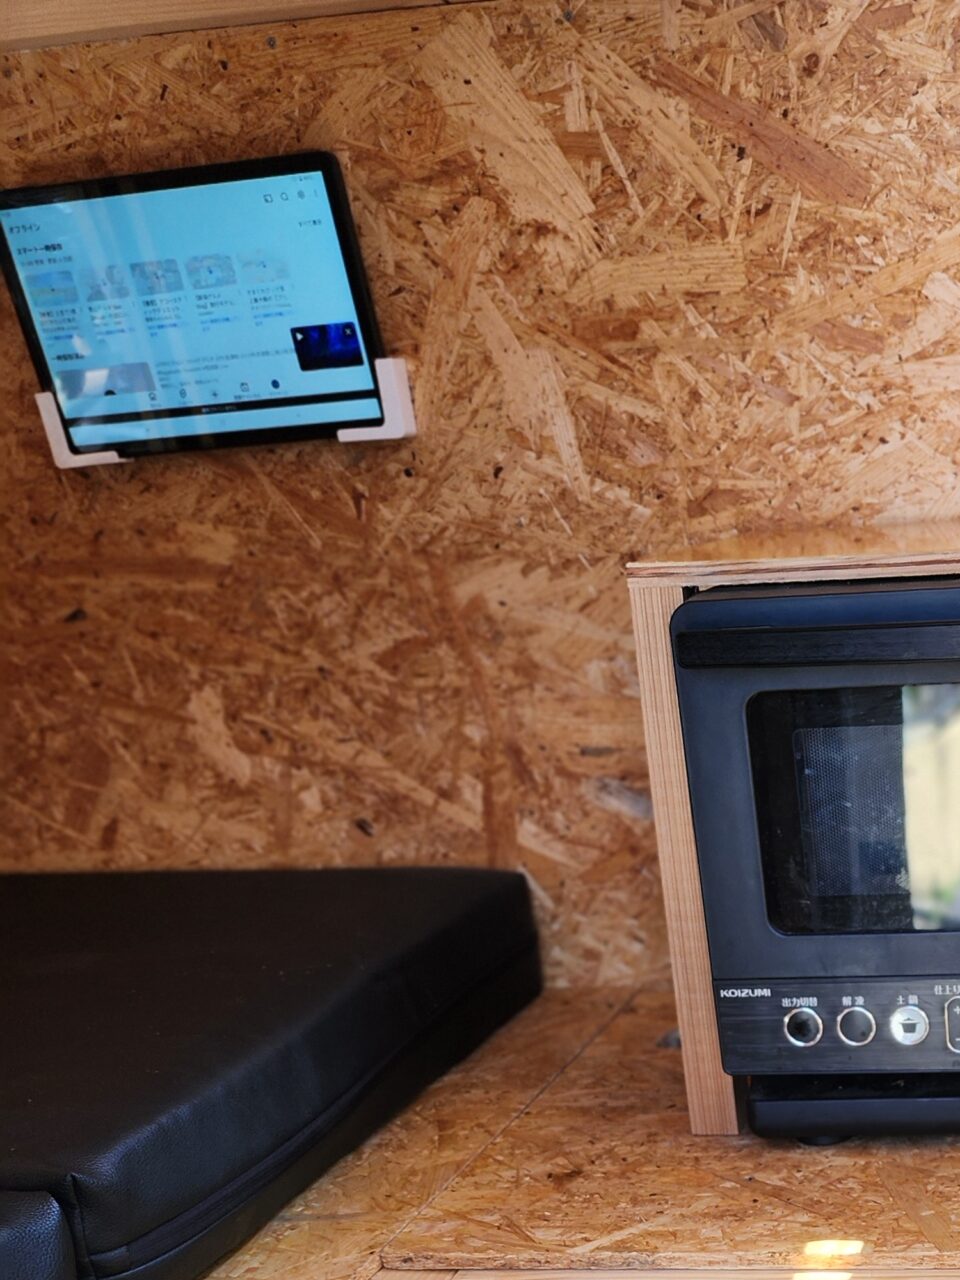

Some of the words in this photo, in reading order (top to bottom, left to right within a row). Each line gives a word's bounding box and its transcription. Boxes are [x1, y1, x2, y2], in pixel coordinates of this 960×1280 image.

[720, 988, 771, 998] KOIZUMI
[782, 997, 818, 1007] 出力切替
